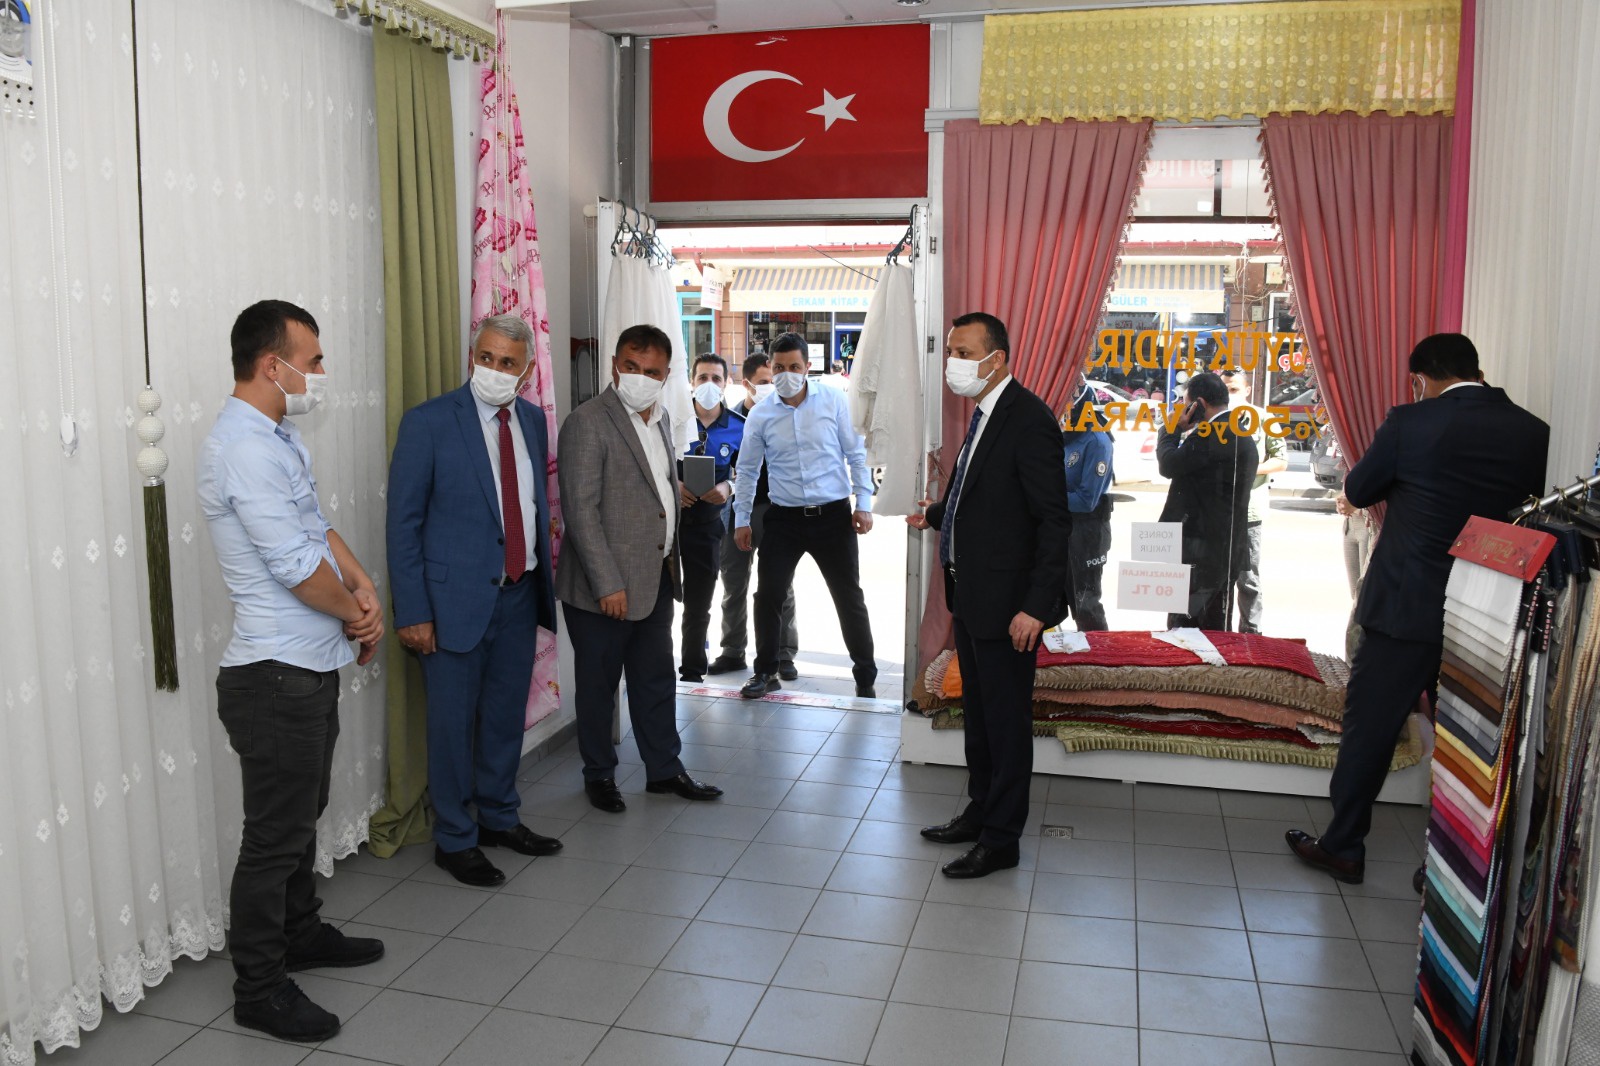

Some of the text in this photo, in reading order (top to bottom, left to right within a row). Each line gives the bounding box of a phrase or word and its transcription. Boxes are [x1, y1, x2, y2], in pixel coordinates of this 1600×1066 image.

[792, 294, 869, 306] ERKAM KİTAP &
[1111, 293, 1148, 306] GÜLER
